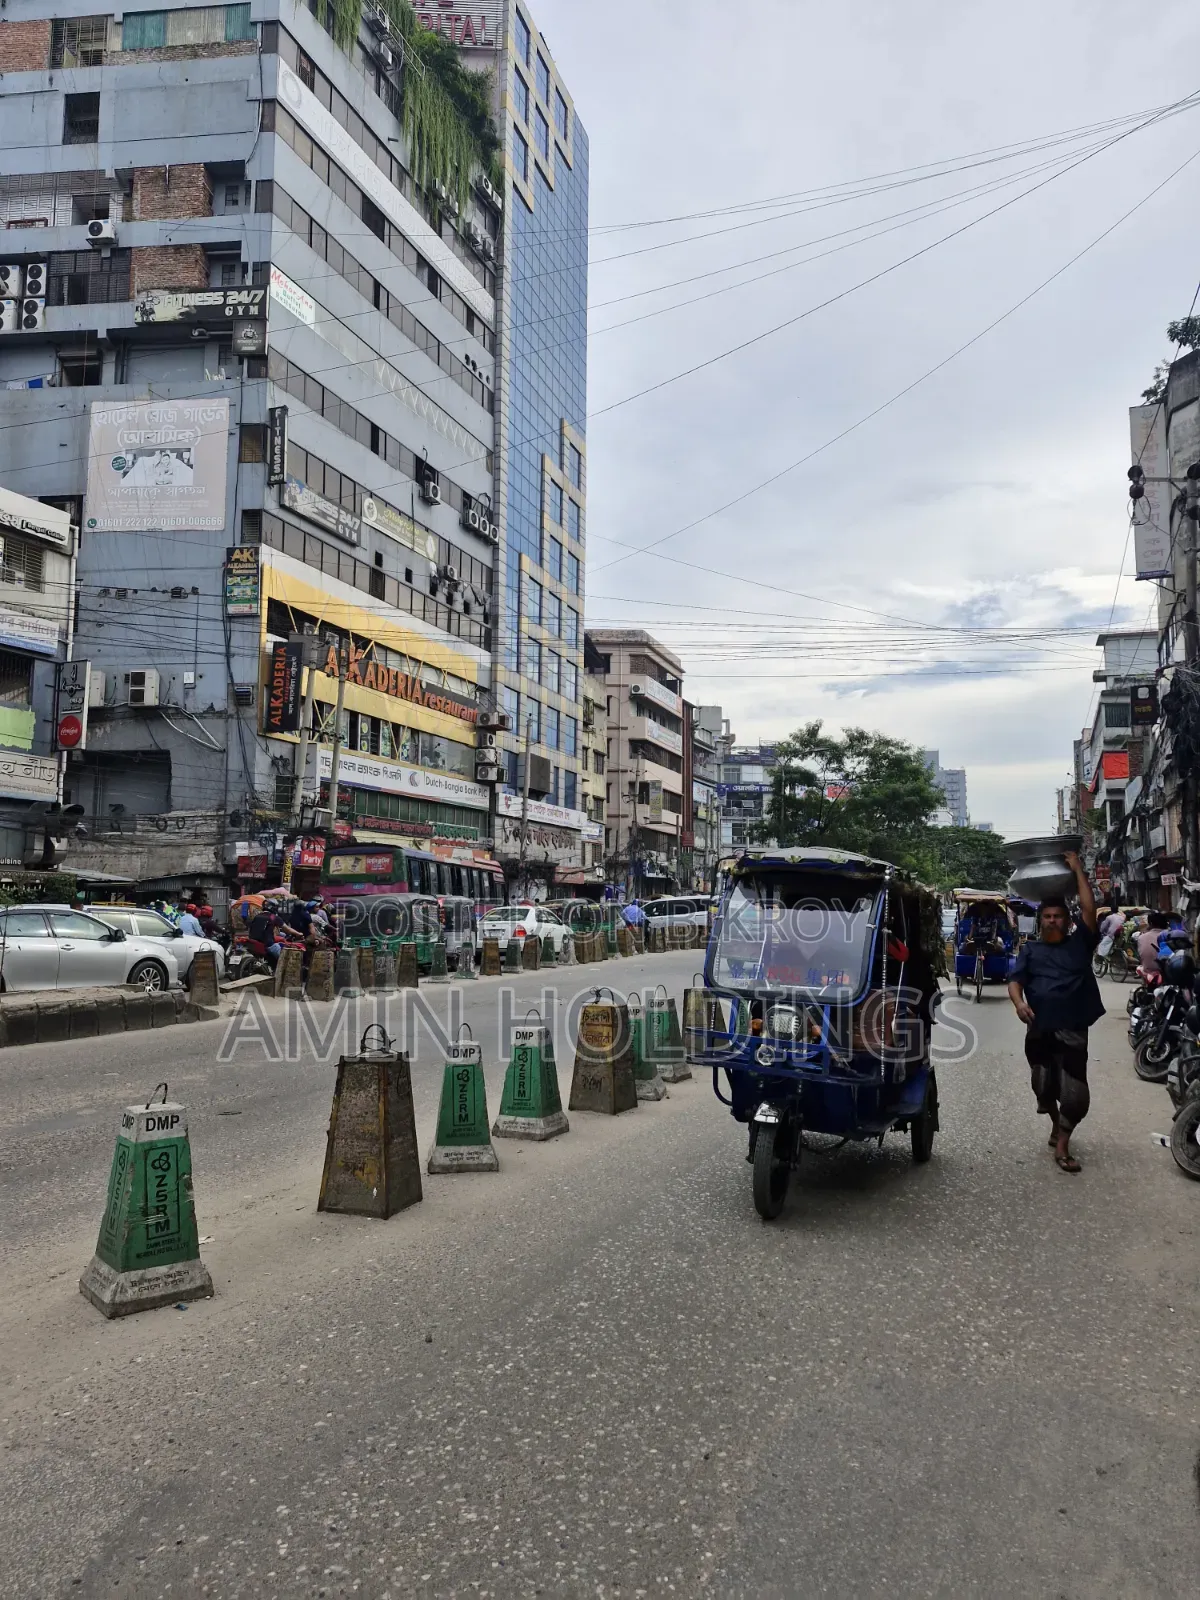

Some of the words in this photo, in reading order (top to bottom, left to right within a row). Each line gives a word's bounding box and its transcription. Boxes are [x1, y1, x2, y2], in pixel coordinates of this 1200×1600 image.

[417, 13, 494, 47] PITAL
[160, 291, 225, 308] FITNESS
[226, 290, 264, 304] 24/7
[225, 305, 259, 316] GYM
[93, 408, 140, 428] হোটেল
[145, 408, 179, 425] রোজ
[184, 400, 227, 425] গার্ডেন
[273, 409, 282, 474] FITNESS
[107, 486, 161, 500] আপনাকে
[339, 508, 361, 530] 24/7
[339, 524, 358, 542] GYM
[231, 548, 254, 562] AK
[270, 646, 287, 726] ALKADERIA
[324, 641, 423, 705] AKADERIA
[423, 690, 479, 723] restaurant
[425, 776, 463, 794] Dutch-Bangla
[464, 785, 478, 795] Bank
[303, 854, 322, 866] Party
[515, 1031, 534, 1041] DMP
[452, 1047, 475, 1059] DMP
[518, 1063, 526, 1098] ZSRM
[458, 1083, 469, 1123] ZSRM
[145, 1115, 180, 1132] DMP
[154, 1174, 171, 1234] ZSRM
